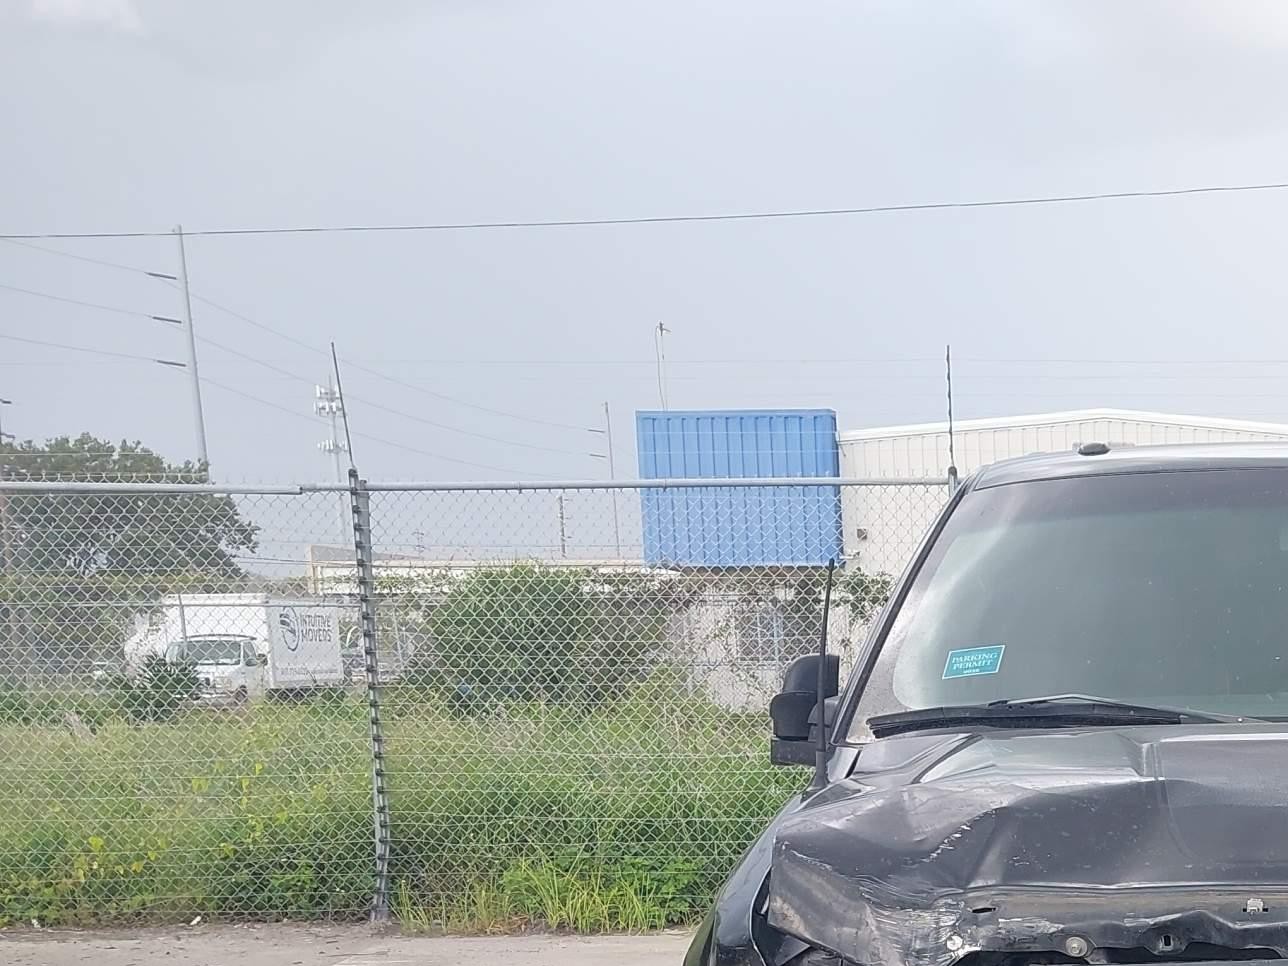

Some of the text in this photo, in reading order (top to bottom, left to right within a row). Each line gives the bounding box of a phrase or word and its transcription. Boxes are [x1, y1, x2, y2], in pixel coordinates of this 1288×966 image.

[300, 614, 332, 628] INTUITIVE
[301, 628, 333, 642] MOVERS
[951, 652, 998, 664] PARKING
[952, 659, 994, 670] PERMIT
